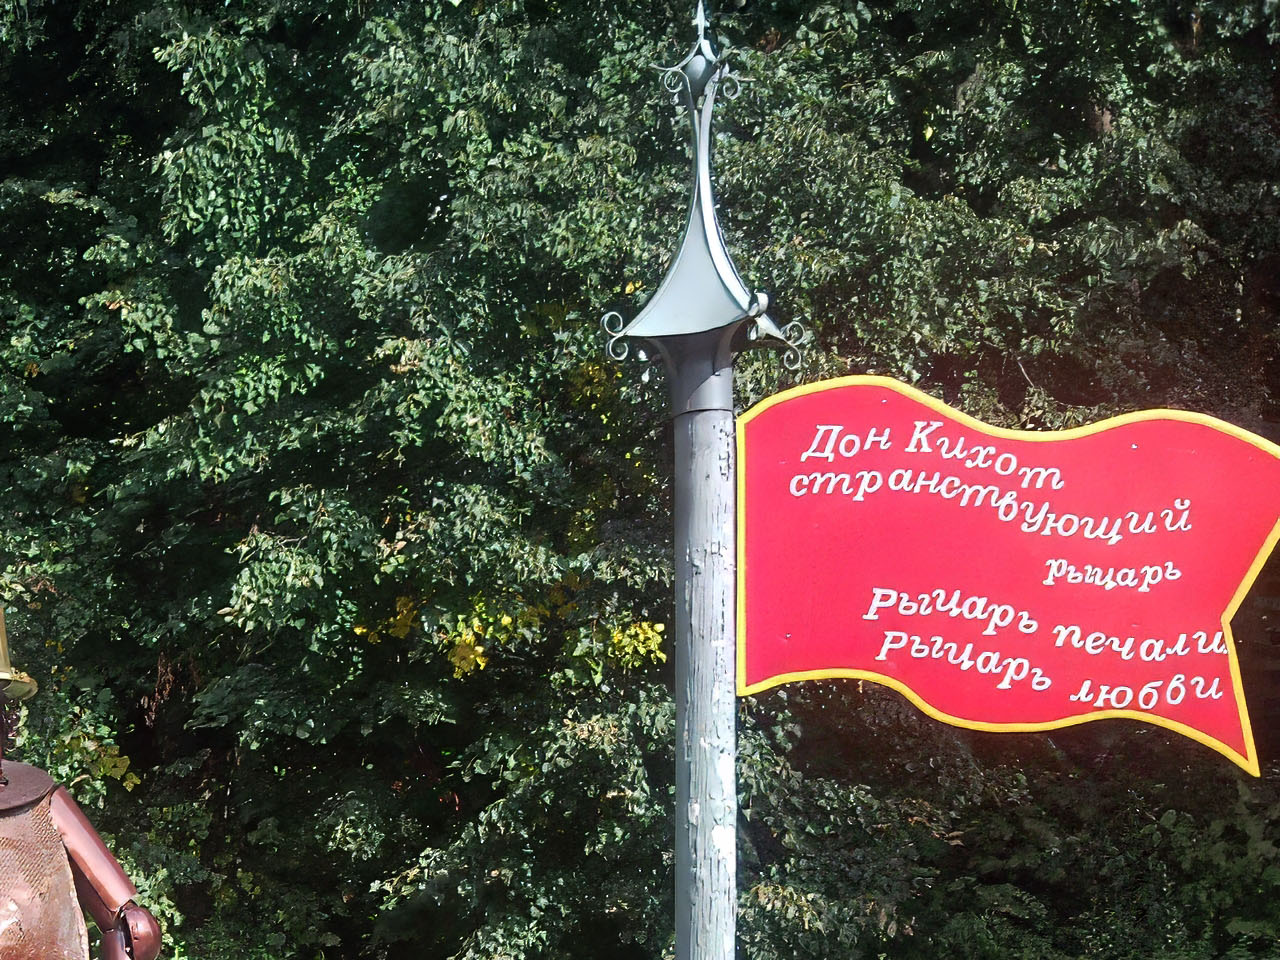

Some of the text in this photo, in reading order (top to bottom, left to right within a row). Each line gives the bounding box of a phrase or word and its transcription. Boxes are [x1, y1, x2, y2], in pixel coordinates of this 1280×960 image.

[800, 420, 1064, 491] Дон Кихот
[789, 469, 1192, 544] странствующий
[1043, 557, 1182, 592] рыцарь
[863, 587, 1228, 662] Рыцарь печали
[875, 631, 1223, 710] Рыцарь любви
